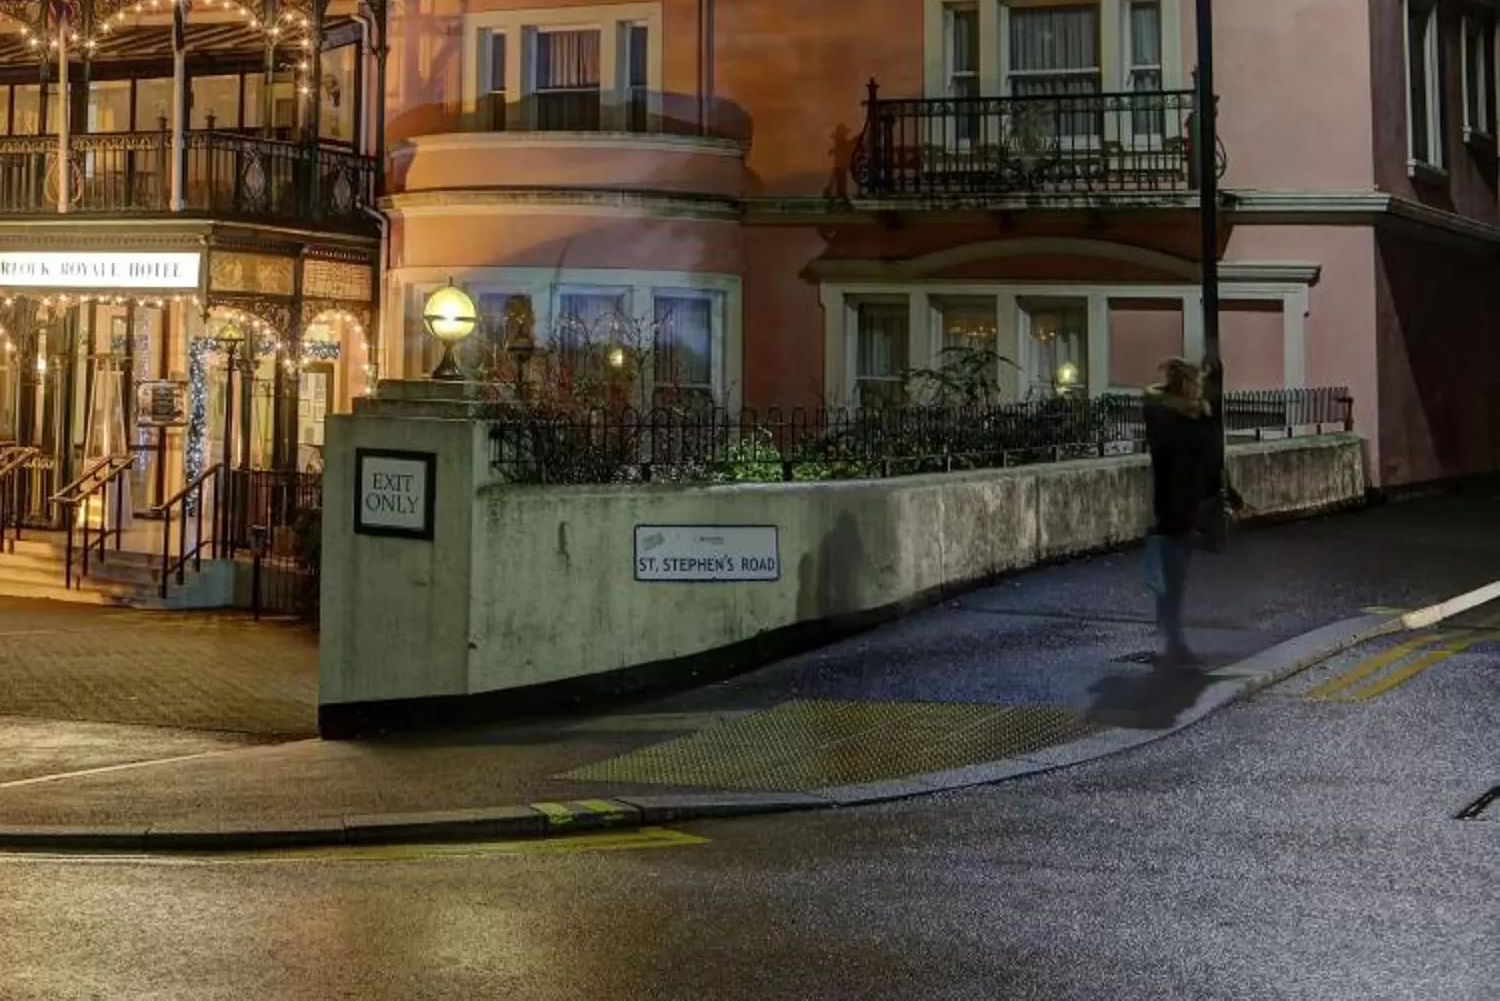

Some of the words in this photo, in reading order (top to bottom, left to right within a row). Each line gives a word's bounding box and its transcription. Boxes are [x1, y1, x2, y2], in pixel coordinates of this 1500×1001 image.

[60, 261, 121, 278] ROYALE
[128, 262, 182, 279] HOTEL
[372, 472, 414, 492] EXIT
[366, 492, 419, 514] ONLY
[663, 555, 734, 572] STEPHEN'S
[741, 557, 775, 572] ROAD
